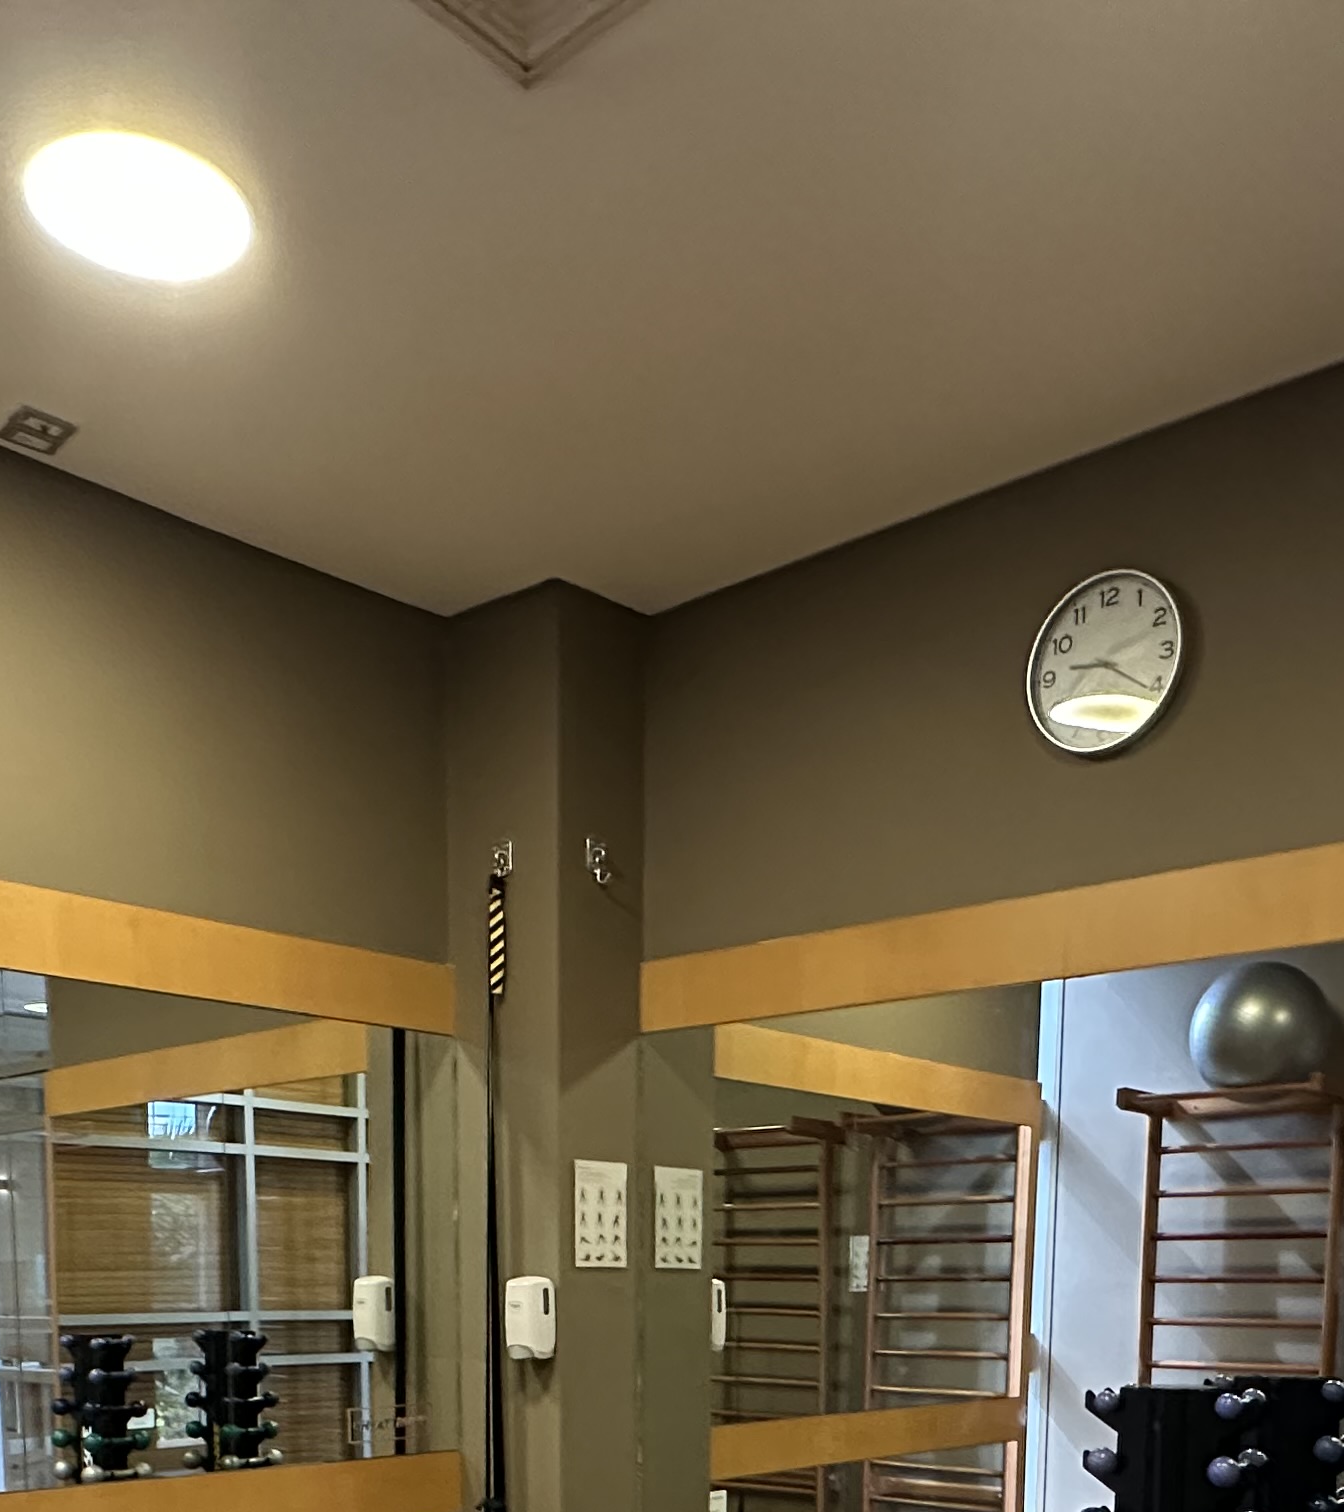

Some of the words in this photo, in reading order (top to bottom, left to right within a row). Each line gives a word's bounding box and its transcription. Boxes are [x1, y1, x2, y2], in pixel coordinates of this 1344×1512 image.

[1099, 587, 1120, 609] 12
[1137, 589, 1144, 607] 1
[1073, 605, 1086, 625] 11
[1152, 607, 1167, 627] 2
[1052, 635, 1073, 656] 10
[1158, 640, 1175, 660] 3
[1042, 670, 1057, 689] 9
[1150, 675, 1164, 693] 4
